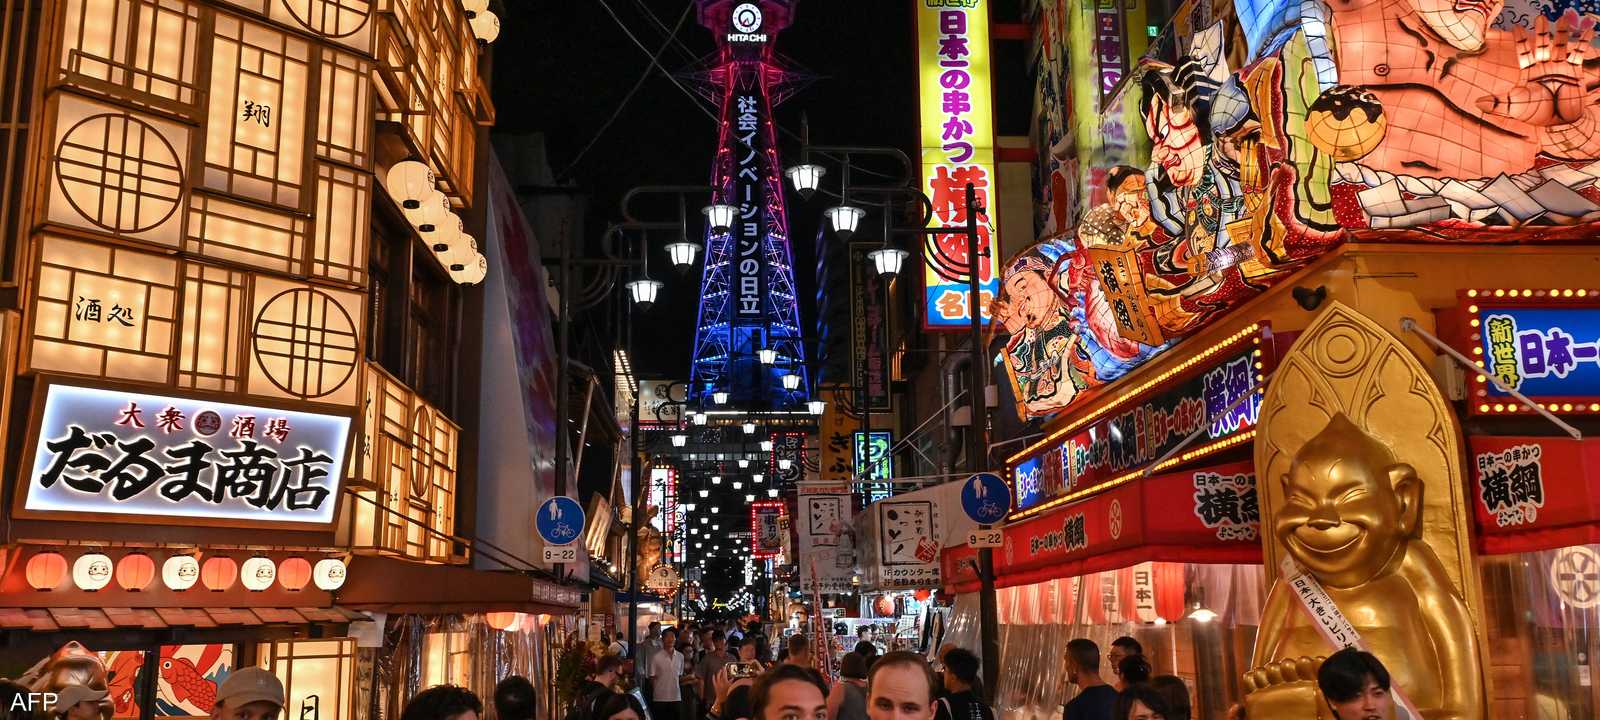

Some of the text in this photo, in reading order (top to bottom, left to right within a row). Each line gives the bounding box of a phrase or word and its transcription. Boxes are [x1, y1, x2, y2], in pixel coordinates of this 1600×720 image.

[727, 33, 767, 42] HITACHI
[938, 10, 973, 163] 日本一の串かつ
[243, 99, 271, 127] 翔
[737, 95, 760, 314] 社会イノベーションの日立
[75, 296, 135, 328] 酒処
[1099, 260, 1136, 332] 横綱
[1488, 317, 1520, 390] 新世界
[1204, 357, 1252, 437] 横綱
[117, 402, 293, 443] 大衆 酒場
[40, 426, 334, 511] だるま商店
[1479, 446, 1540, 470] 日本一の串かつ
[1481, 461, 1543, 511] 横綱
[1063, 514, 1087, 550] 横綱
[1135, 571, 1152, 609] 日本一
